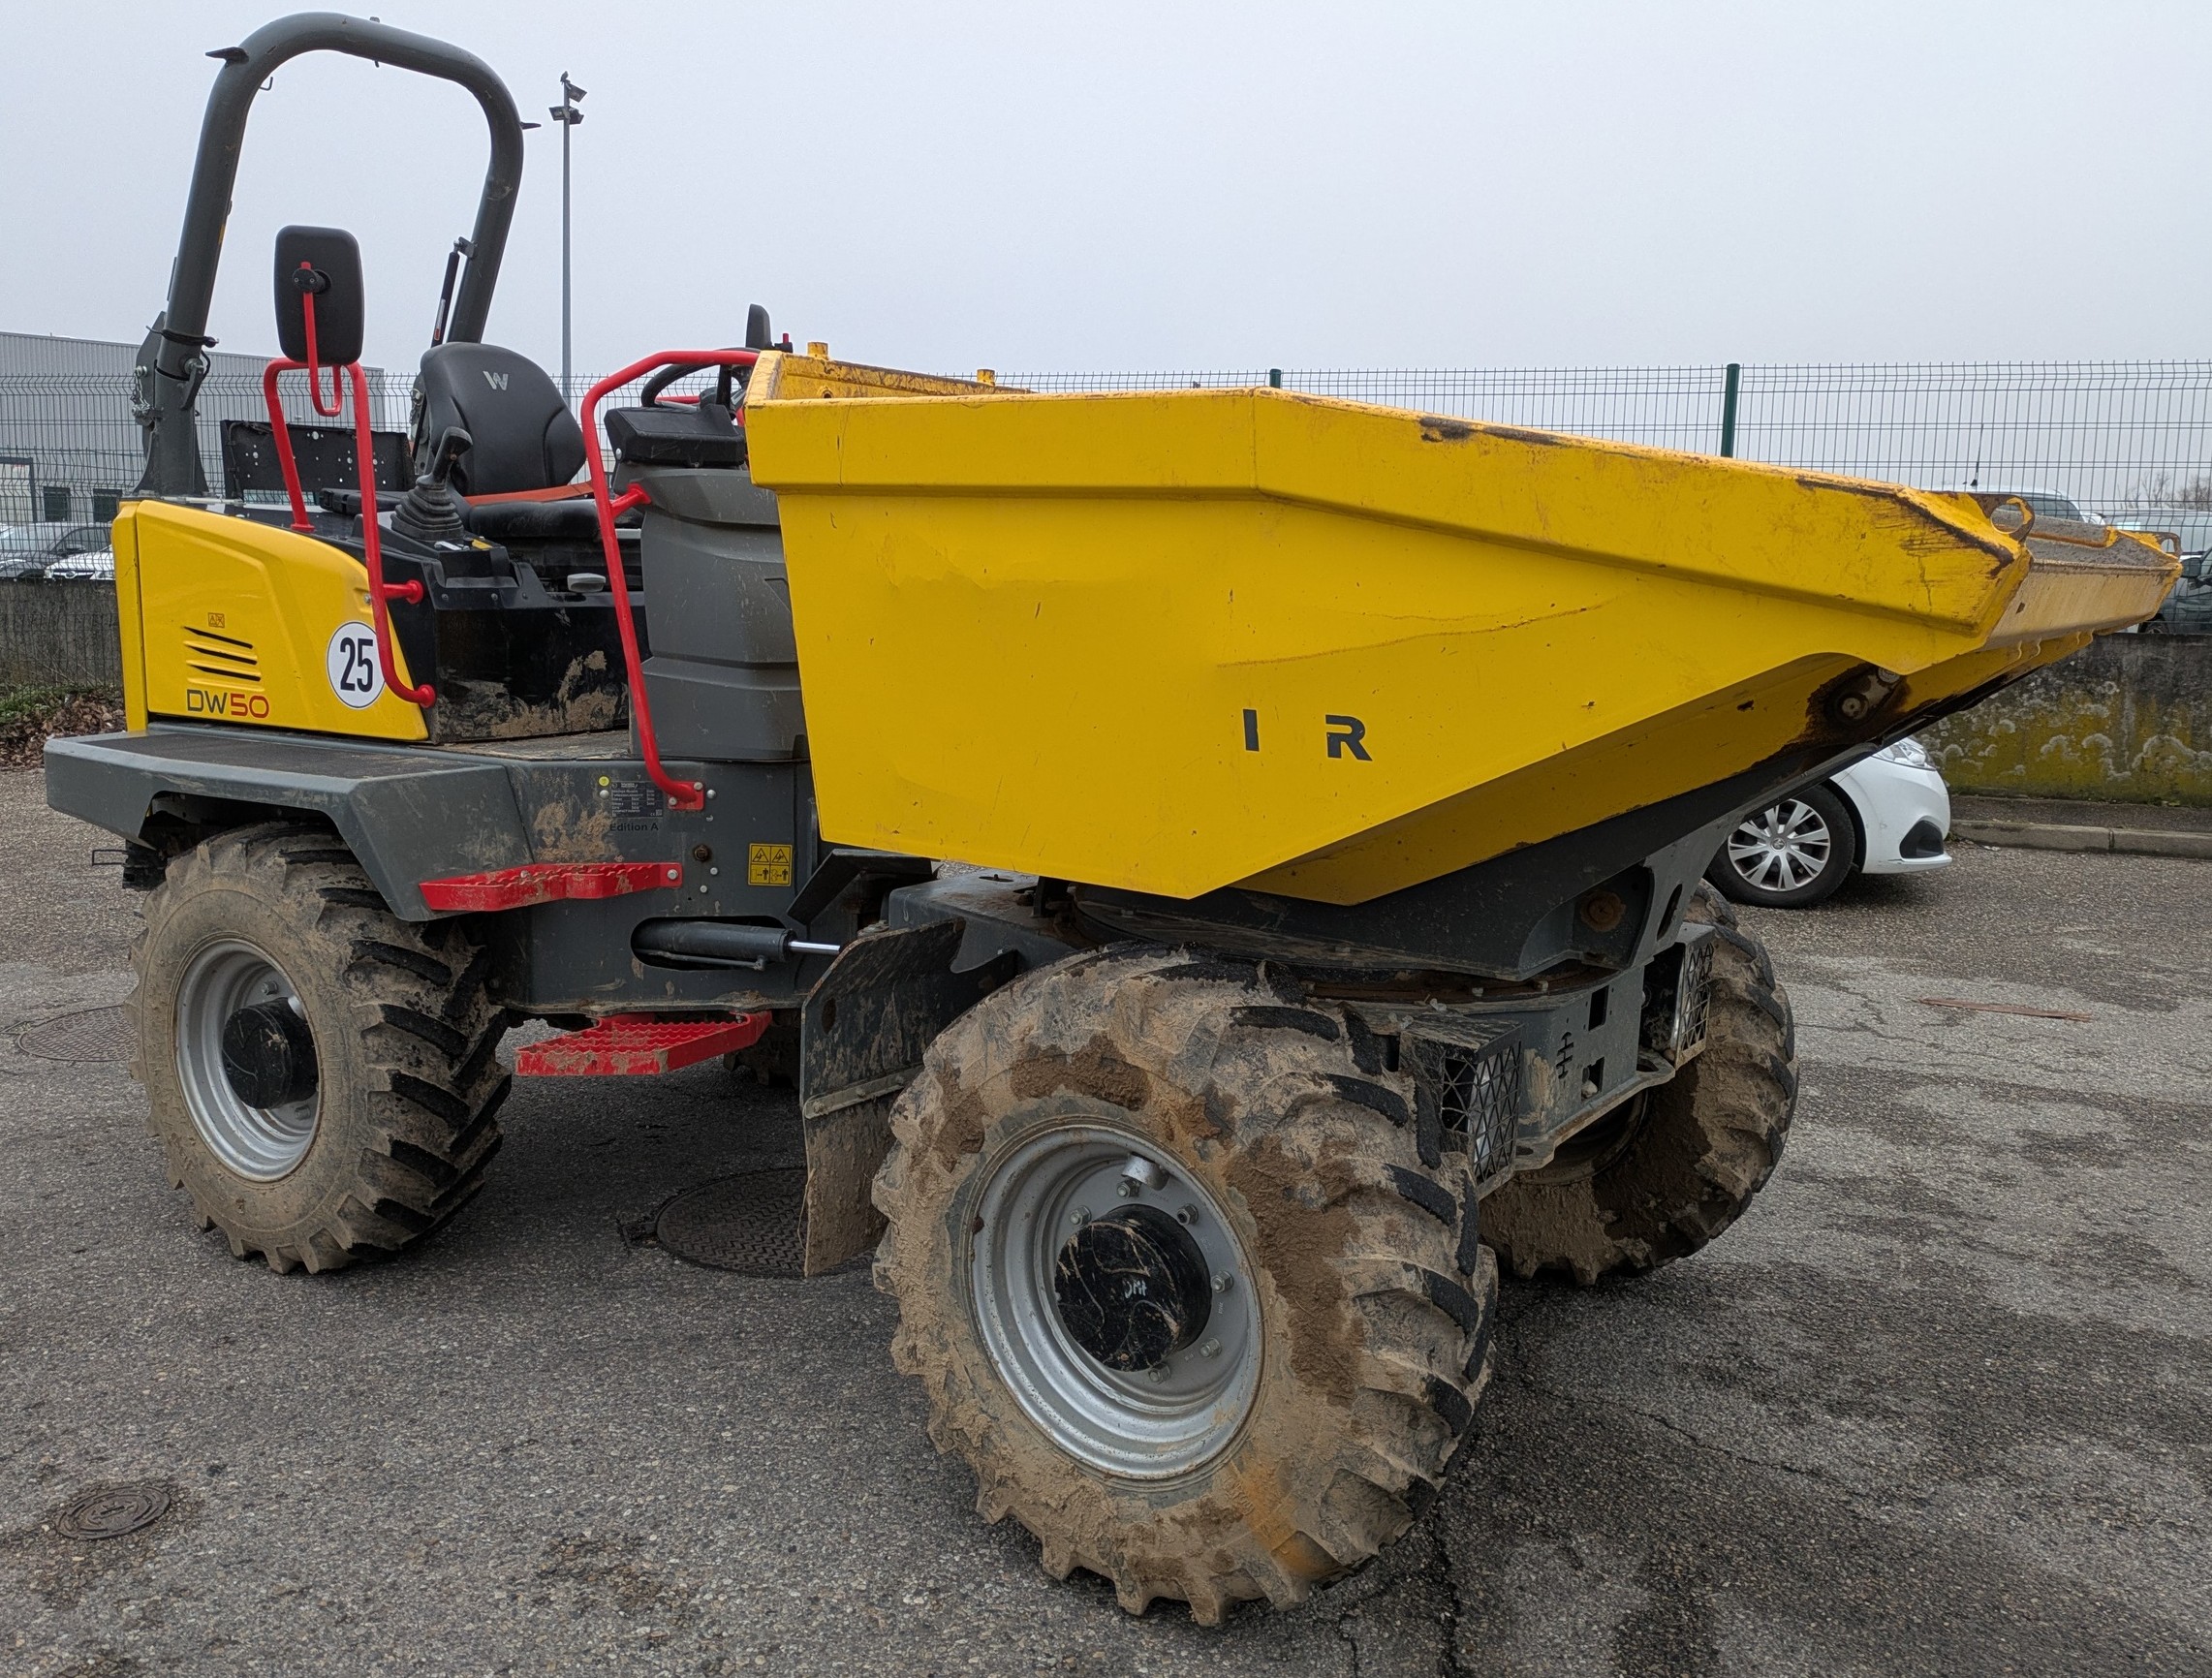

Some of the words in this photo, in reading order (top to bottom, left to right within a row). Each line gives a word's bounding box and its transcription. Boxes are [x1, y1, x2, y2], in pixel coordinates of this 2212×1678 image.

[483, 370, 509, 390] W
[340, 637, 374, 693] 25
[186, 689, 270, 719] DW50
[610, 823, 648, 831] Edition
[650, 823, 659, 831] A
